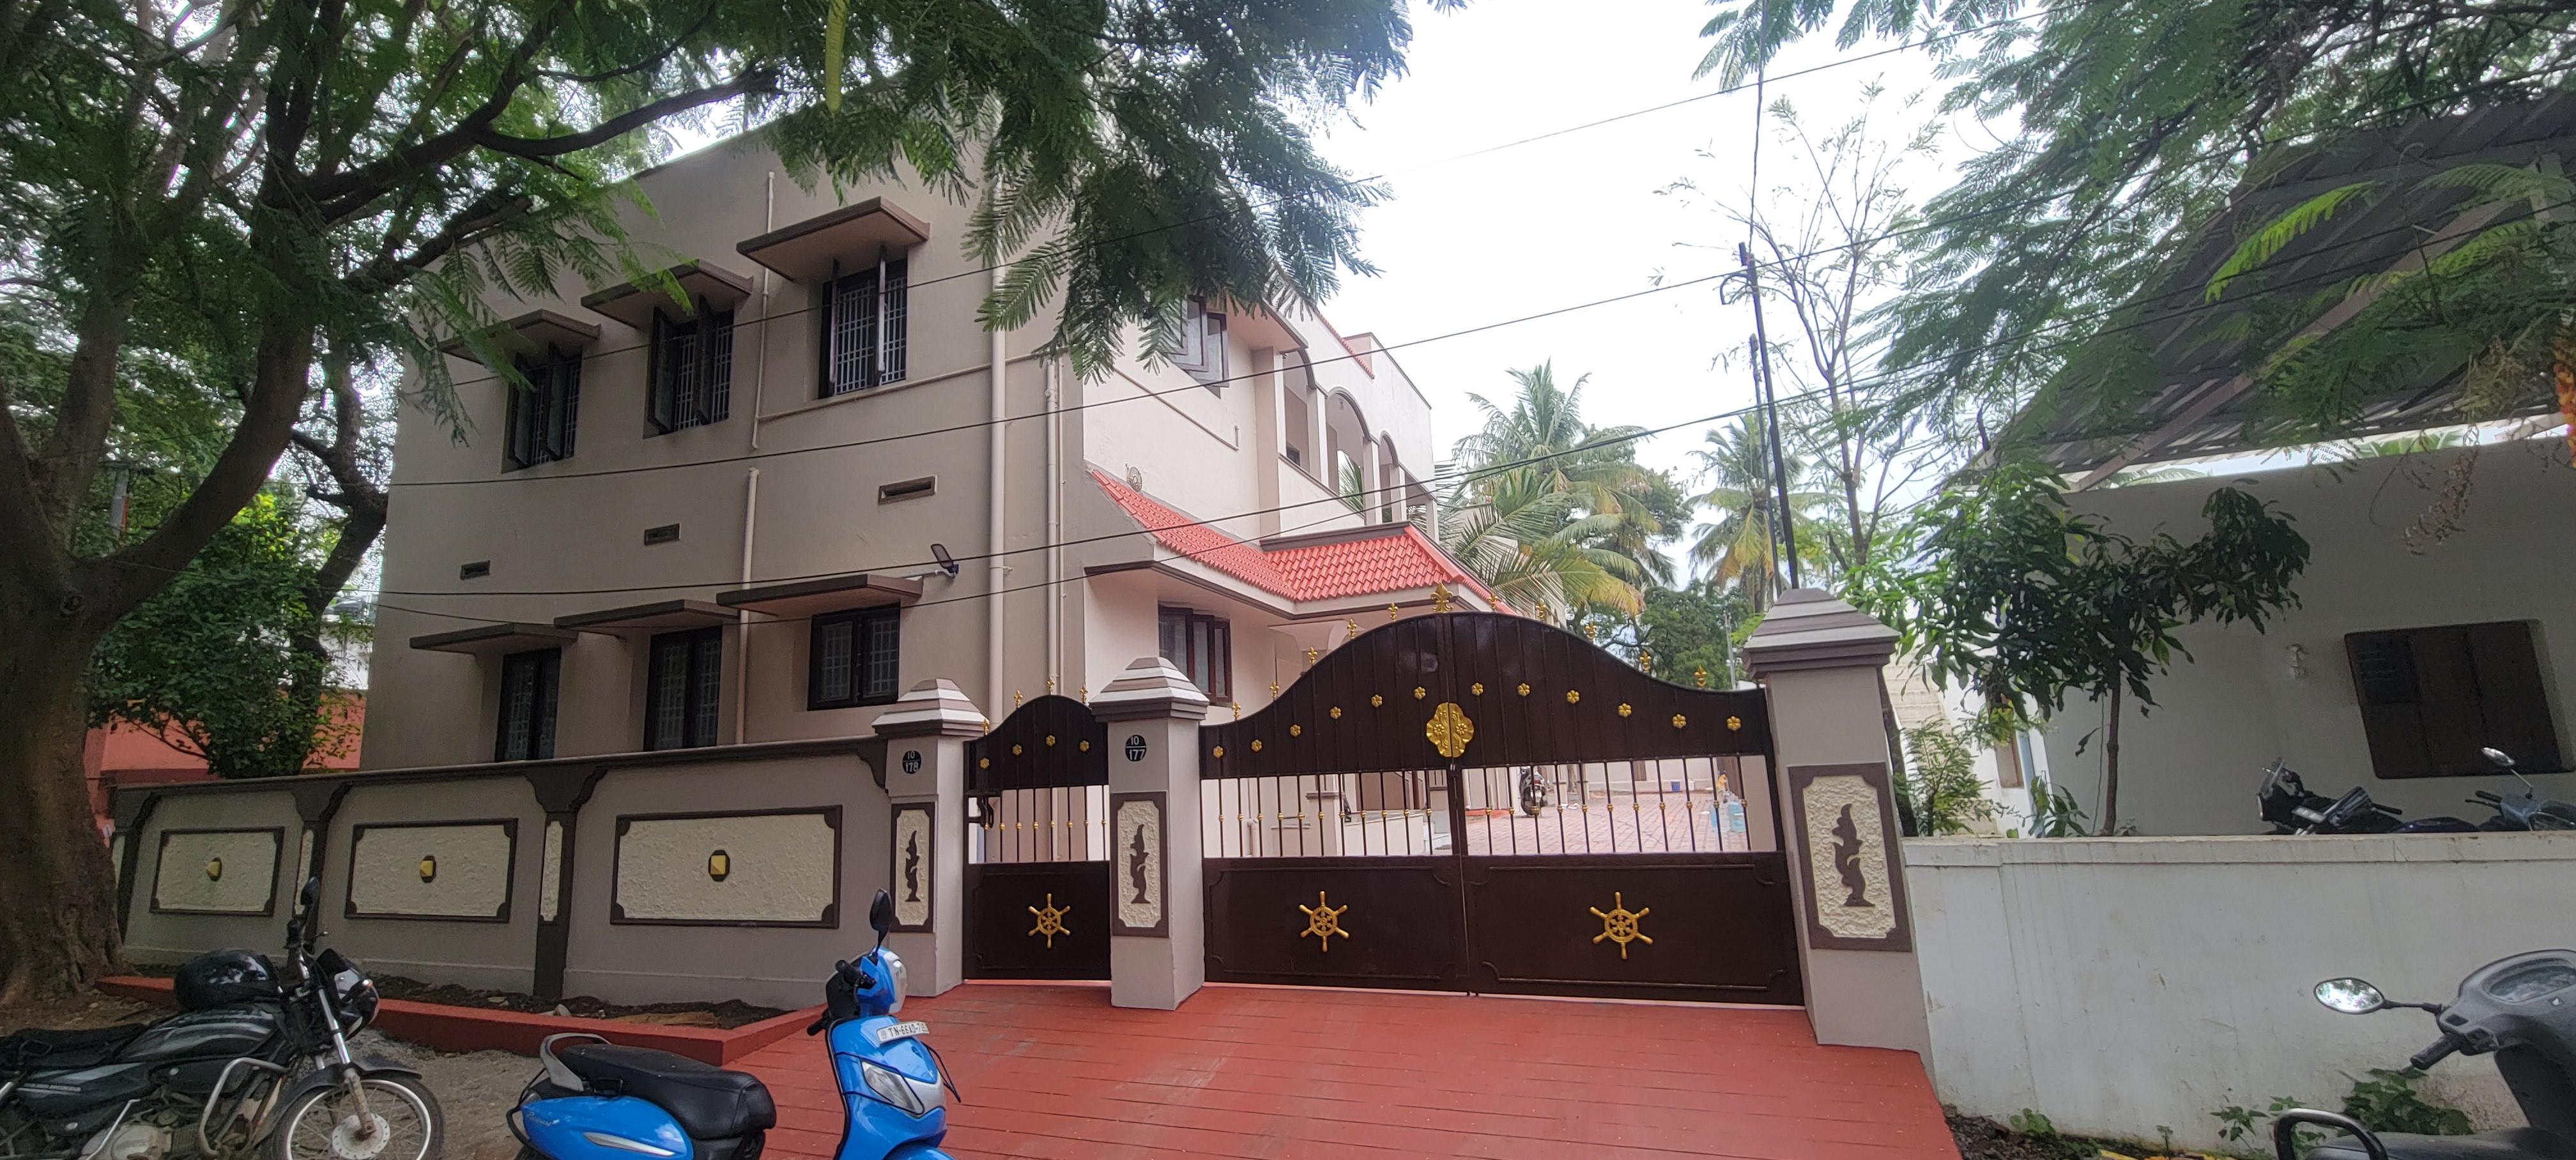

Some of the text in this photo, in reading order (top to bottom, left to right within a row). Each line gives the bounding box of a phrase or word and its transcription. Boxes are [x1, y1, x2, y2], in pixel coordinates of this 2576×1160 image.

[1131, 736, 1140, 745] 10
[907, 751, 915, 759] 10
[1129, 749, 1146, 760] 177
[905, 761, 919, 772] 178
